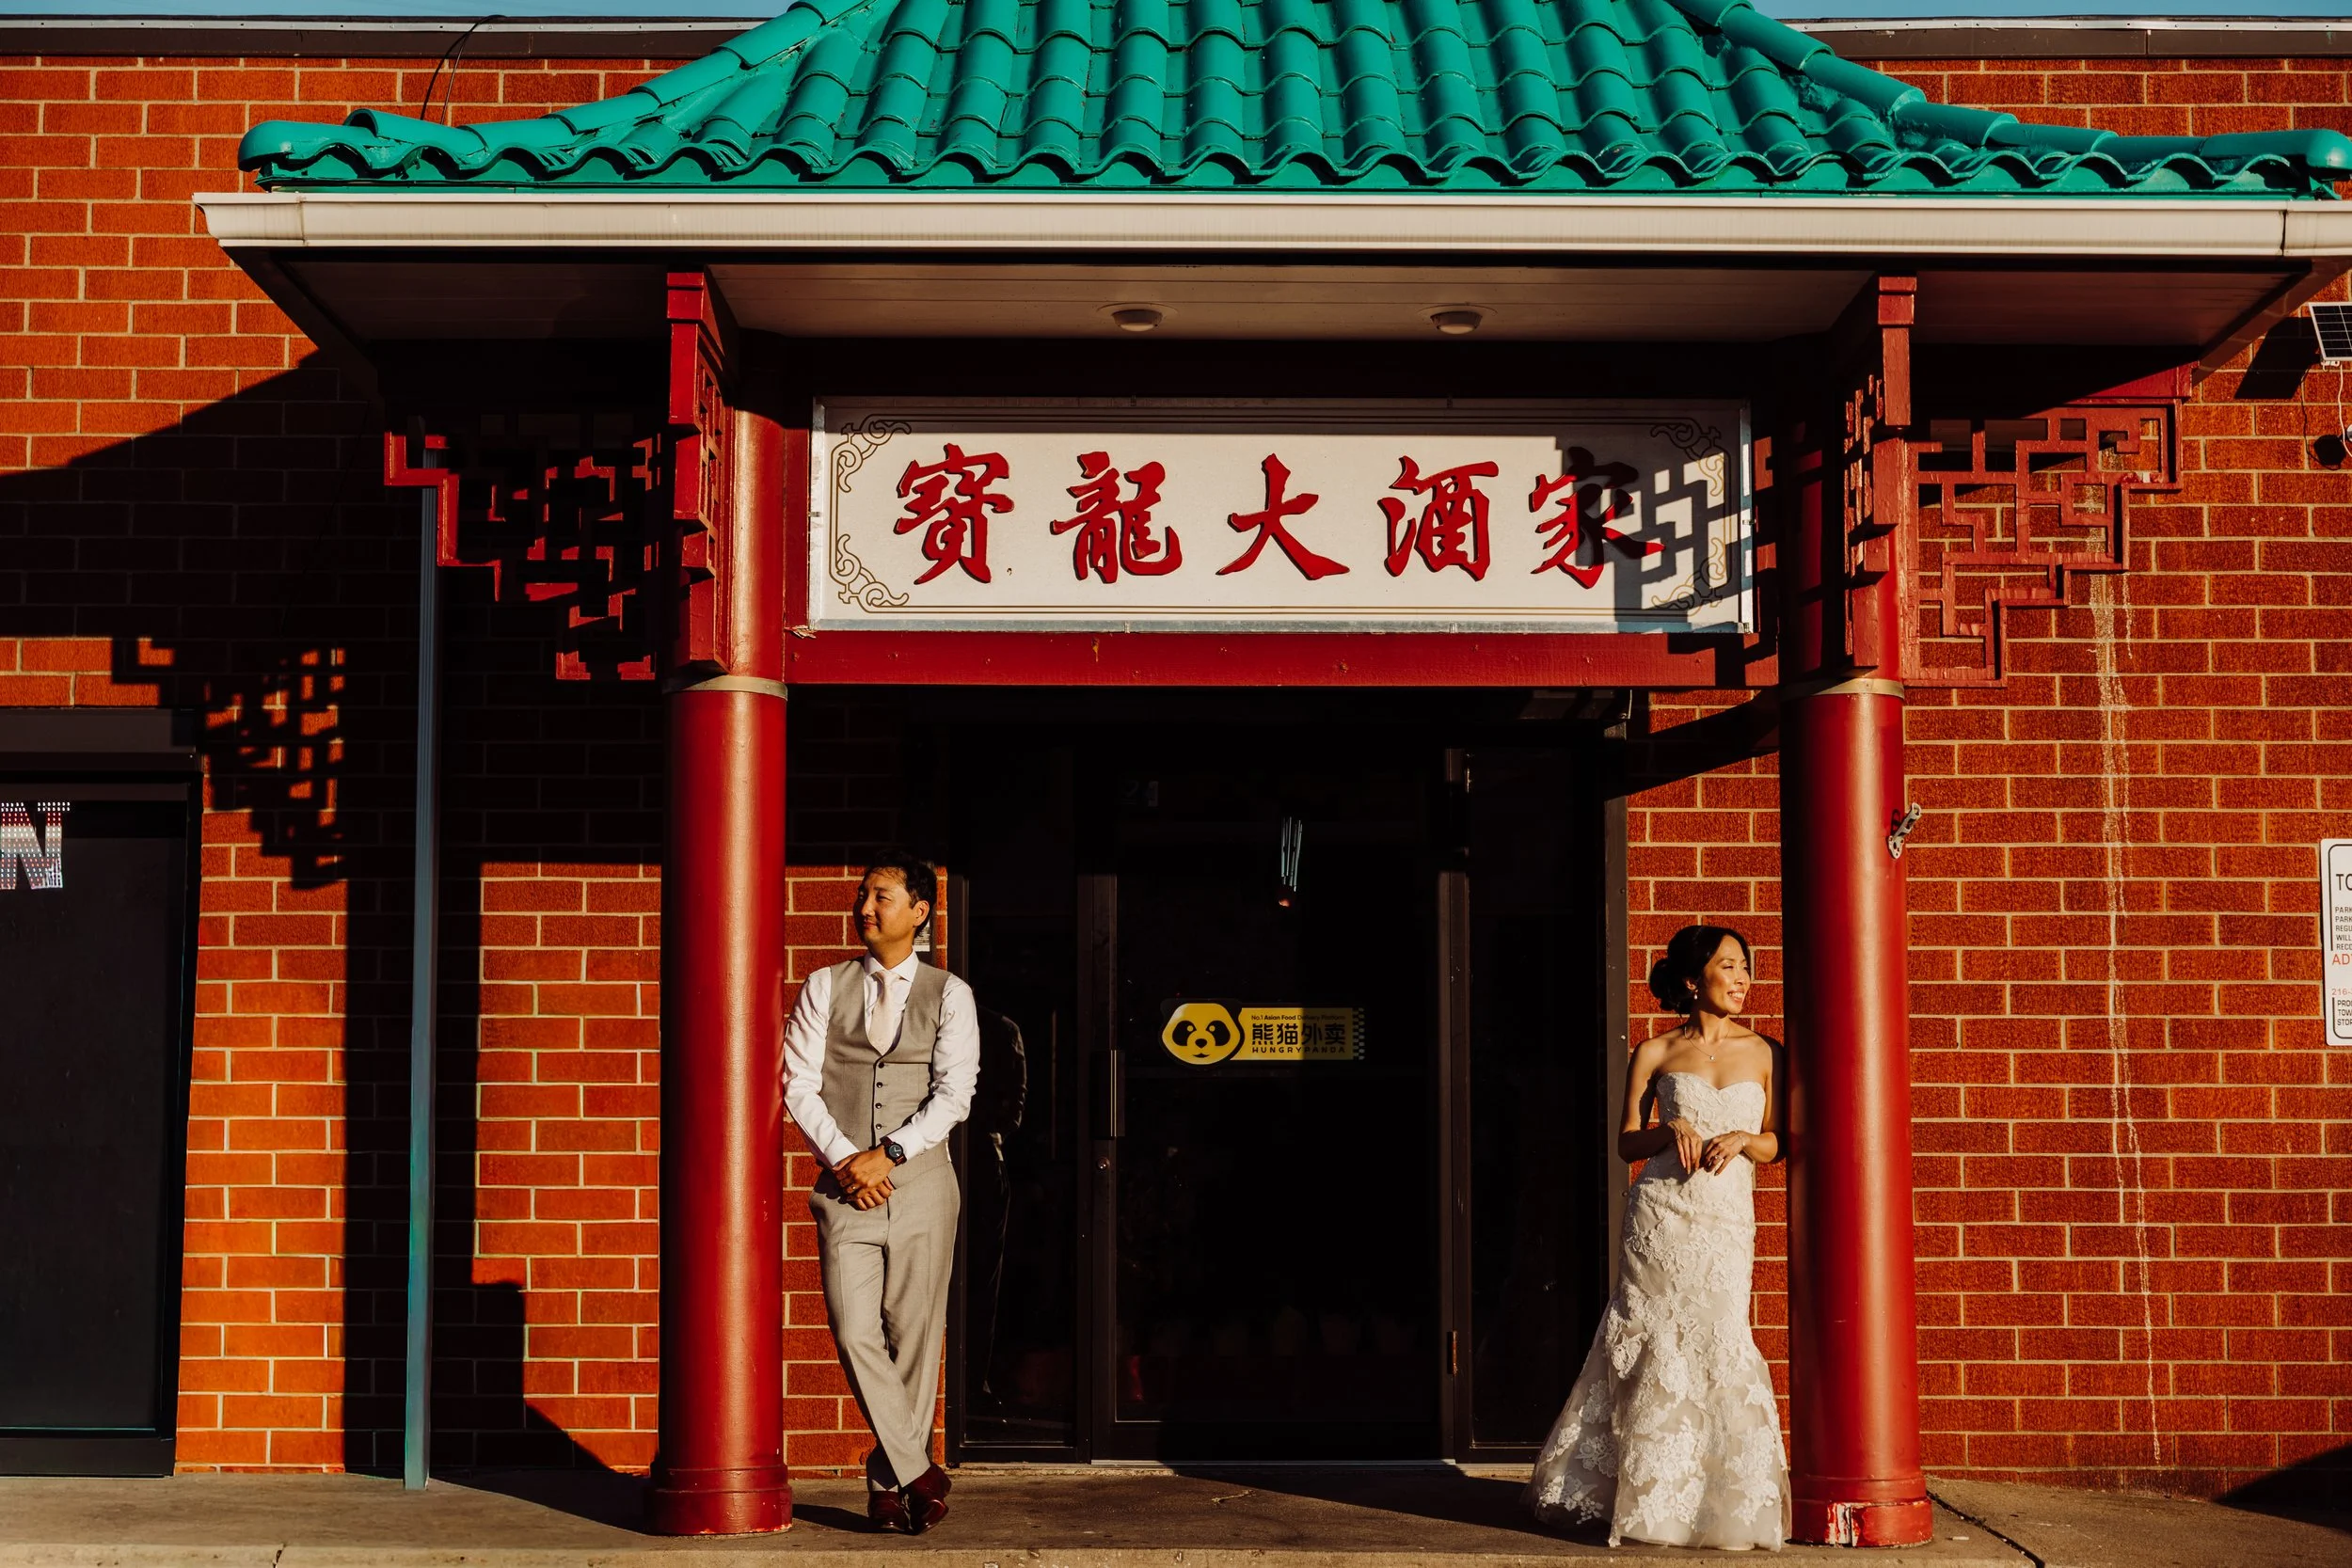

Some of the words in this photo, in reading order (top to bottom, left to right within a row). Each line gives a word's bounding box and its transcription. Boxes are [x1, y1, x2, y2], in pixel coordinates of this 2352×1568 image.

[893, 442, 1666, 590] 寶龍大酒家
[2332, 953, 2352, 965] AD
[2332, 988, 2352, 996] 216-
[2337, 999, 2352, 1007] PRO
[1252, 1022, 1346, 1045] 熊猫外卖
